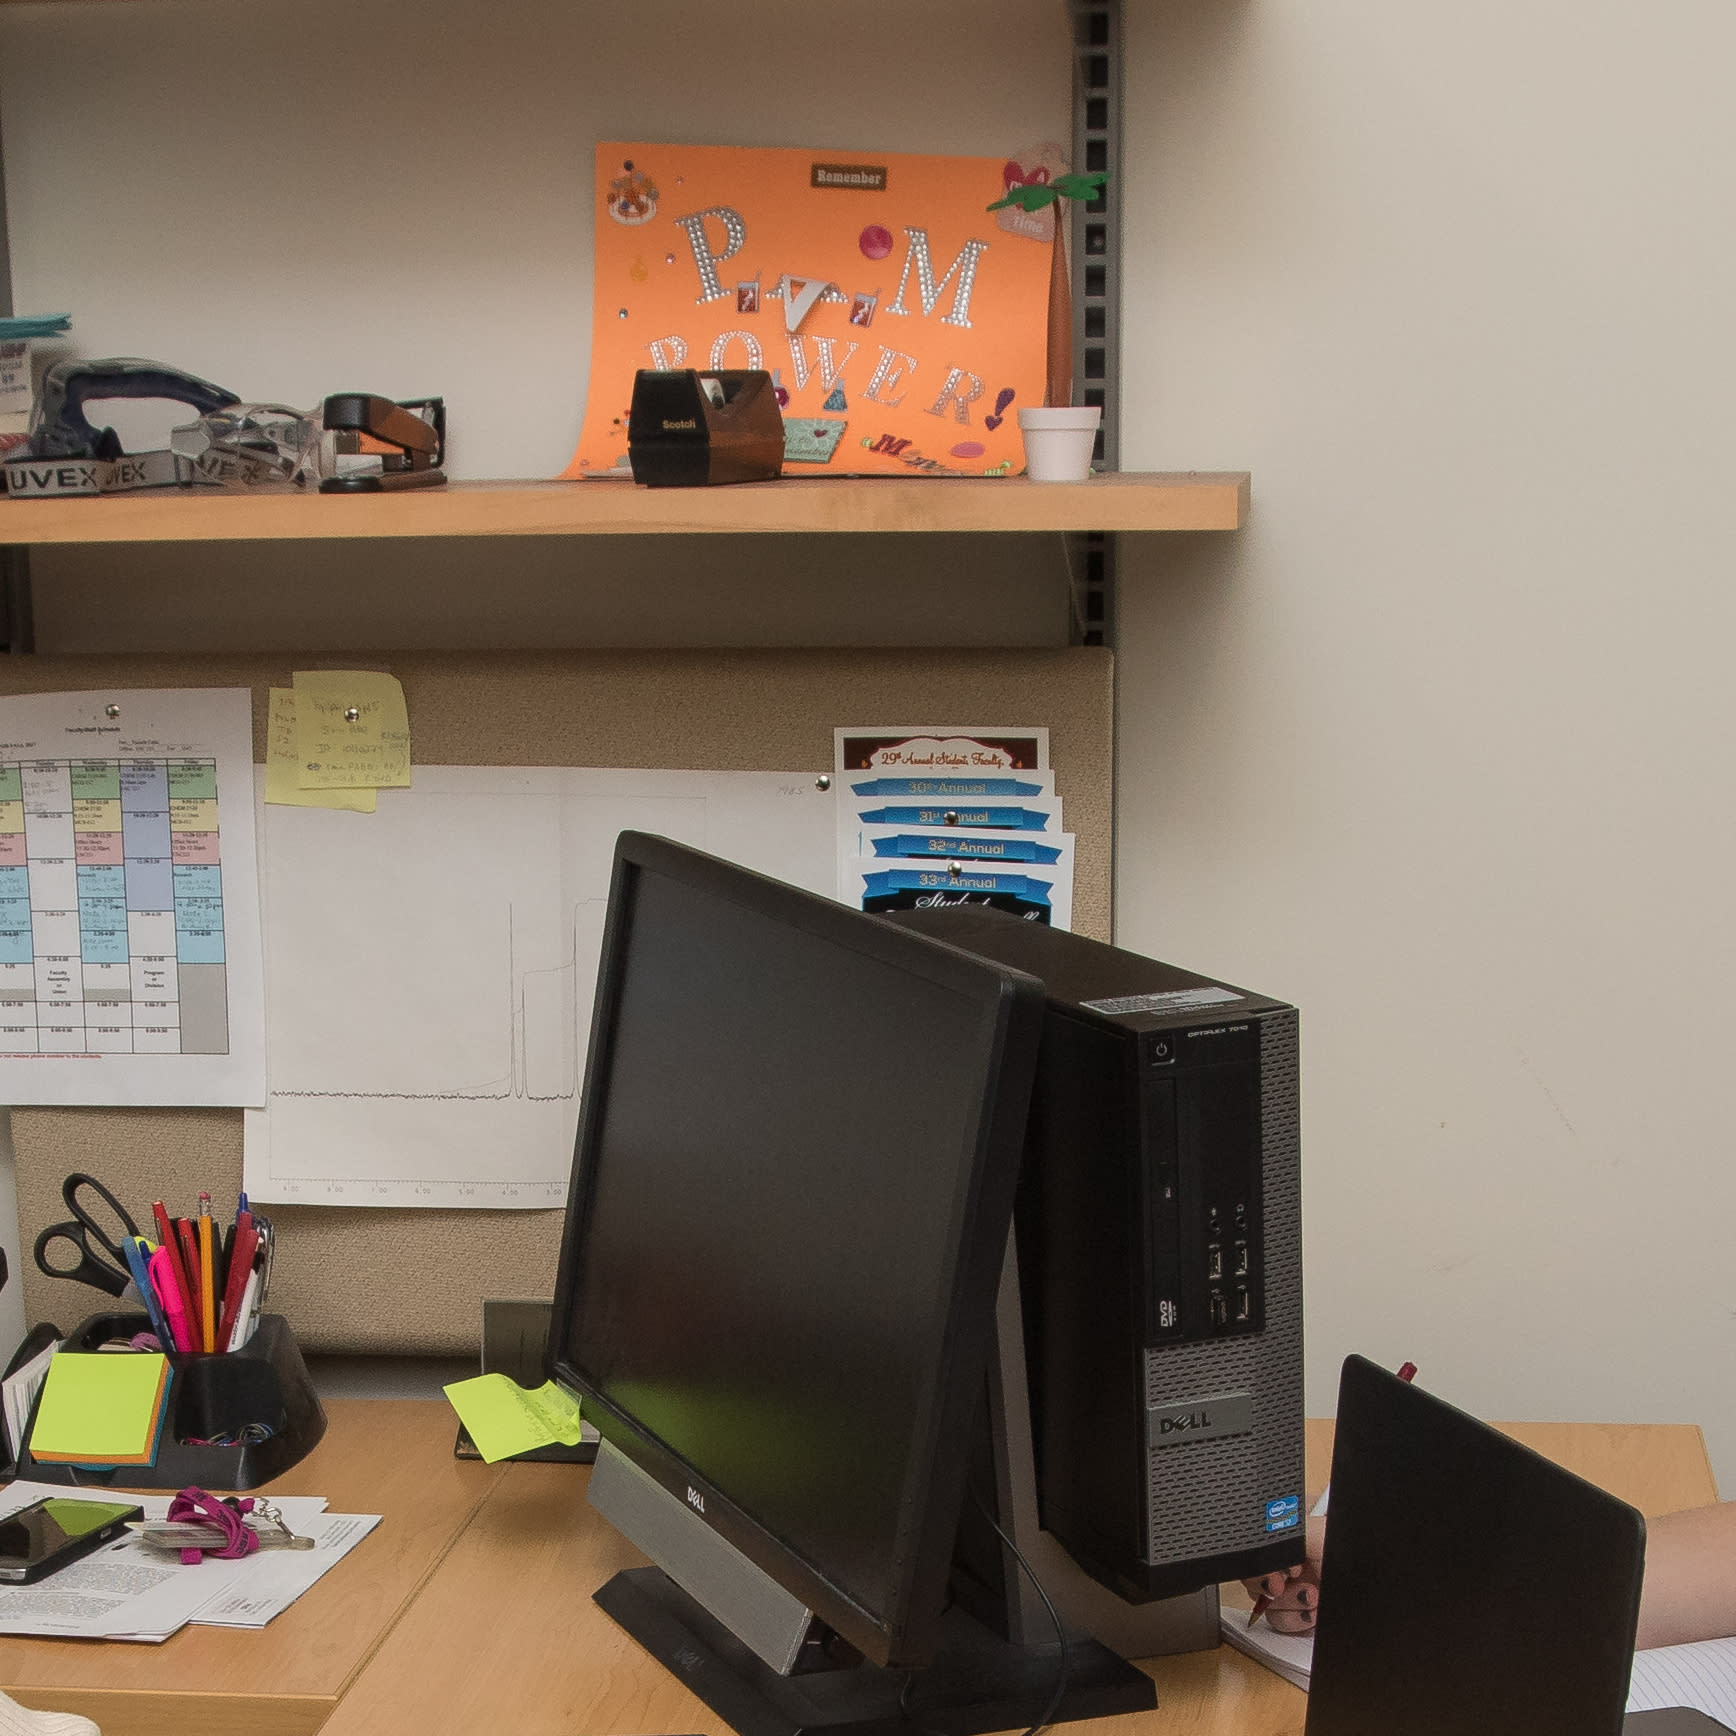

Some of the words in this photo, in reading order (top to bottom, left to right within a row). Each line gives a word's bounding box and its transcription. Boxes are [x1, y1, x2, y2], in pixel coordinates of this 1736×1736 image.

[816, 169, 882, 187] Remember
[663, 419, 696, 429] Scotch
[9, 467, 97, 490] UVEX
[937, 783, 986, 793] Annual
[959, 841, 1004, 854] Annual
[920, 874, 946, 886] 33rd
[949, 876, 996, 888] Annual
[1160, 1411, 1211, 1434] DELL
[686, 1485, 706, 1514] DELL
